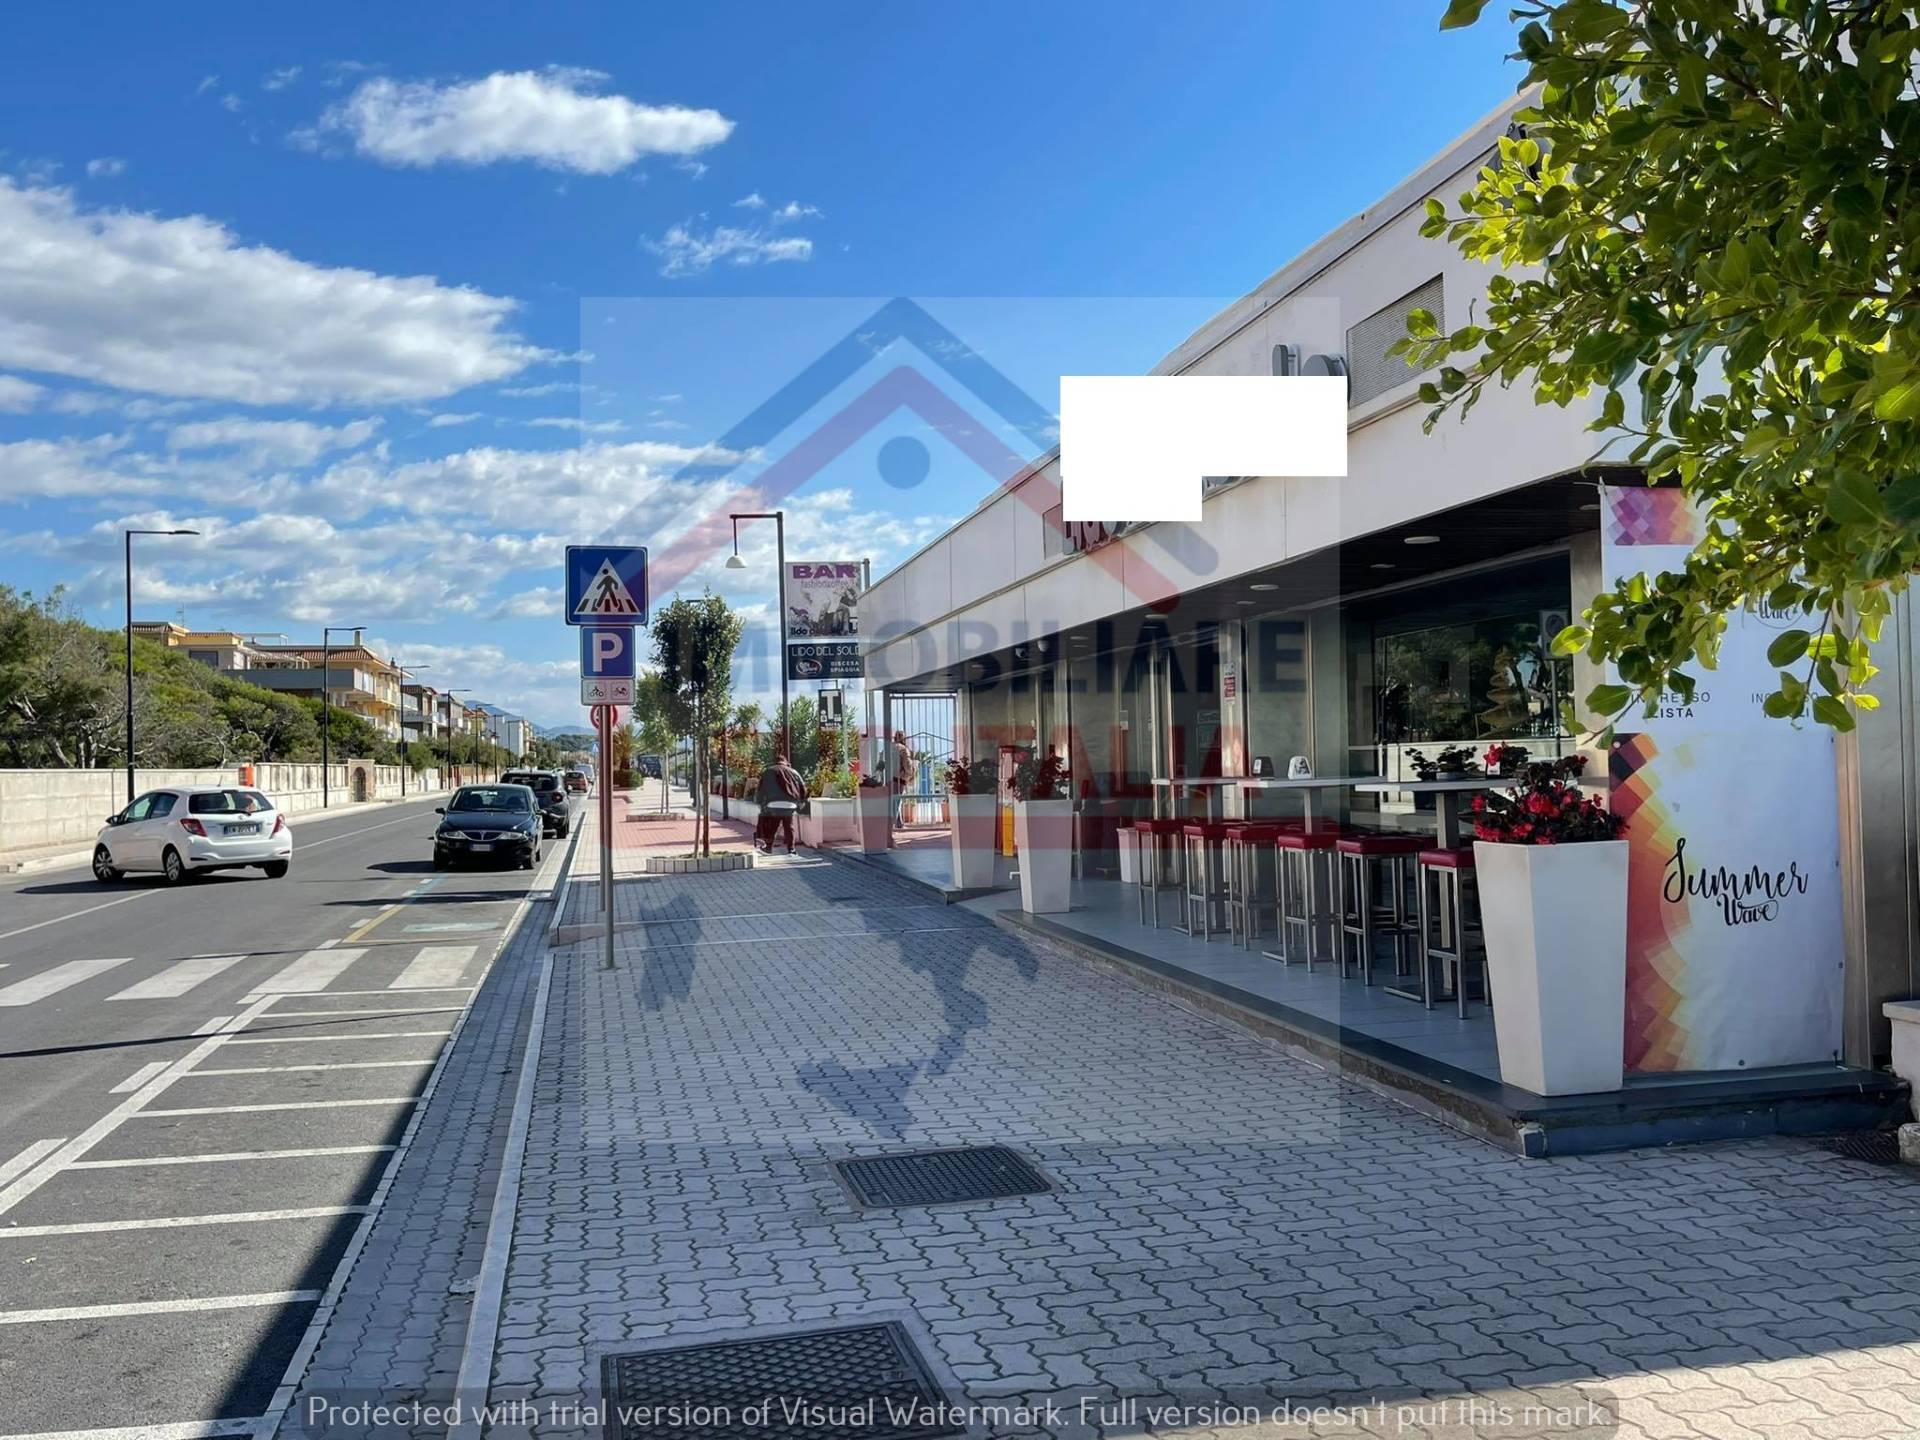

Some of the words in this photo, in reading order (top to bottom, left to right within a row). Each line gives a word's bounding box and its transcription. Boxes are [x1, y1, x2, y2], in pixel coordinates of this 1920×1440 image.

[793, 565, 856, 579] BAR
[591, 632, 624, 673] P
[791, 646, 815, 657] LIDO
[816, 645, 834, 656] DEL
[821, 690, 839, 720] T
[1631, 691, 1711, 704] INRESO
[1663, 837, 1809, 904] Summer
[1716, 892, 1779, 927] Wave
